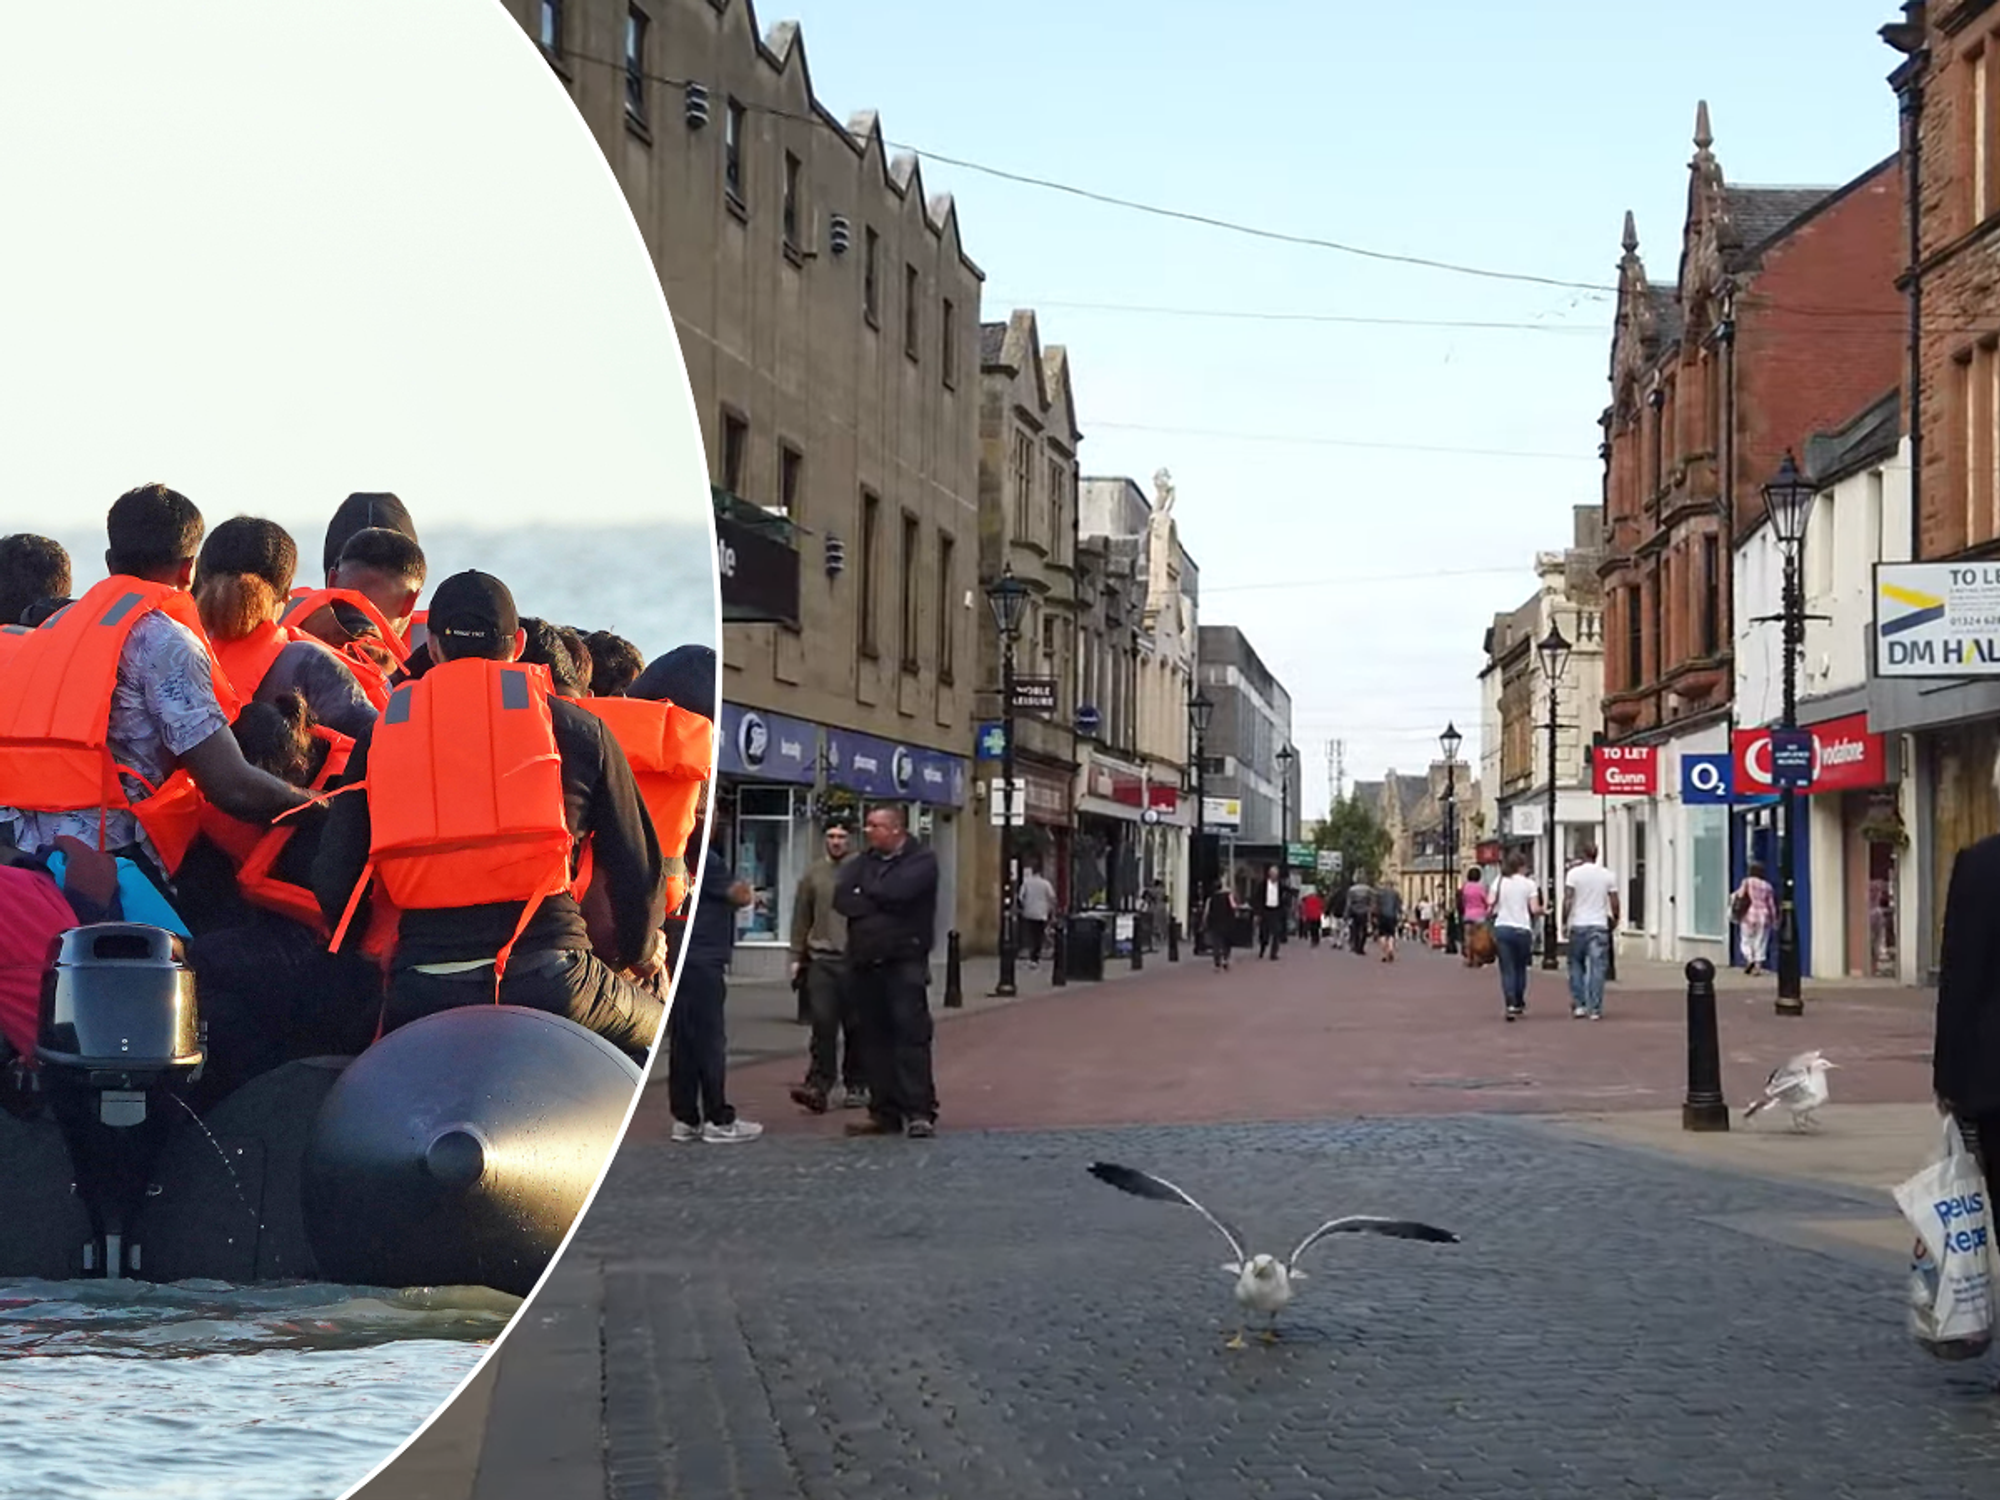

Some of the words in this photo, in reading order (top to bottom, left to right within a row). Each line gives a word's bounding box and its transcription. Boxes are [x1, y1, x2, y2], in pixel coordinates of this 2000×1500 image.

[1949, 569, 1977, 586] TO
[1888, 640, 1935, 665] DM
[1943, 638, 2000, 665] HAL
[1602, 748, 1621, 760] TO
[1624, 748, 1649, 760] LET
[1822, 737, 1865, 767] vodafone
[1606, 767, 1646, 784] Gunn
